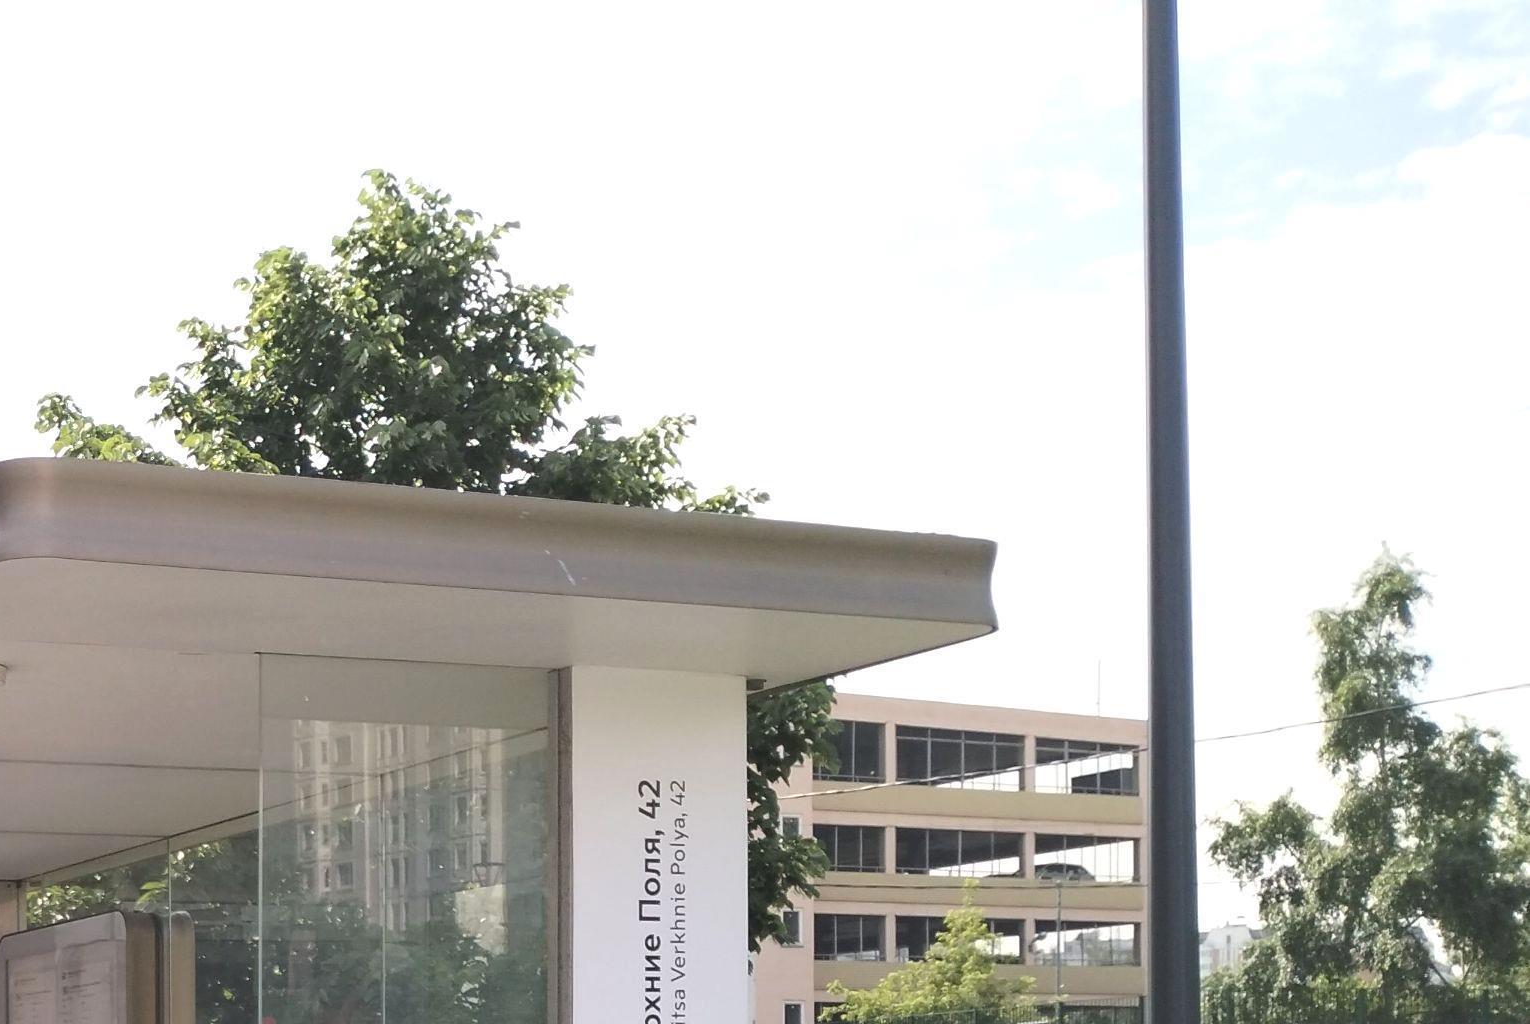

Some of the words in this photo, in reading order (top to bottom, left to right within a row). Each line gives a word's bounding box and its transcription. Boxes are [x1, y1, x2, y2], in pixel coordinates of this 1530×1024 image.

[638, 778, 663, 820] 42
[670, 779, 687, 807] 42
[638, 829, 665, 922] Поля,
[670, 812, 690, 876] Polya,
[670, 884, 687, 984] Verkhnie
